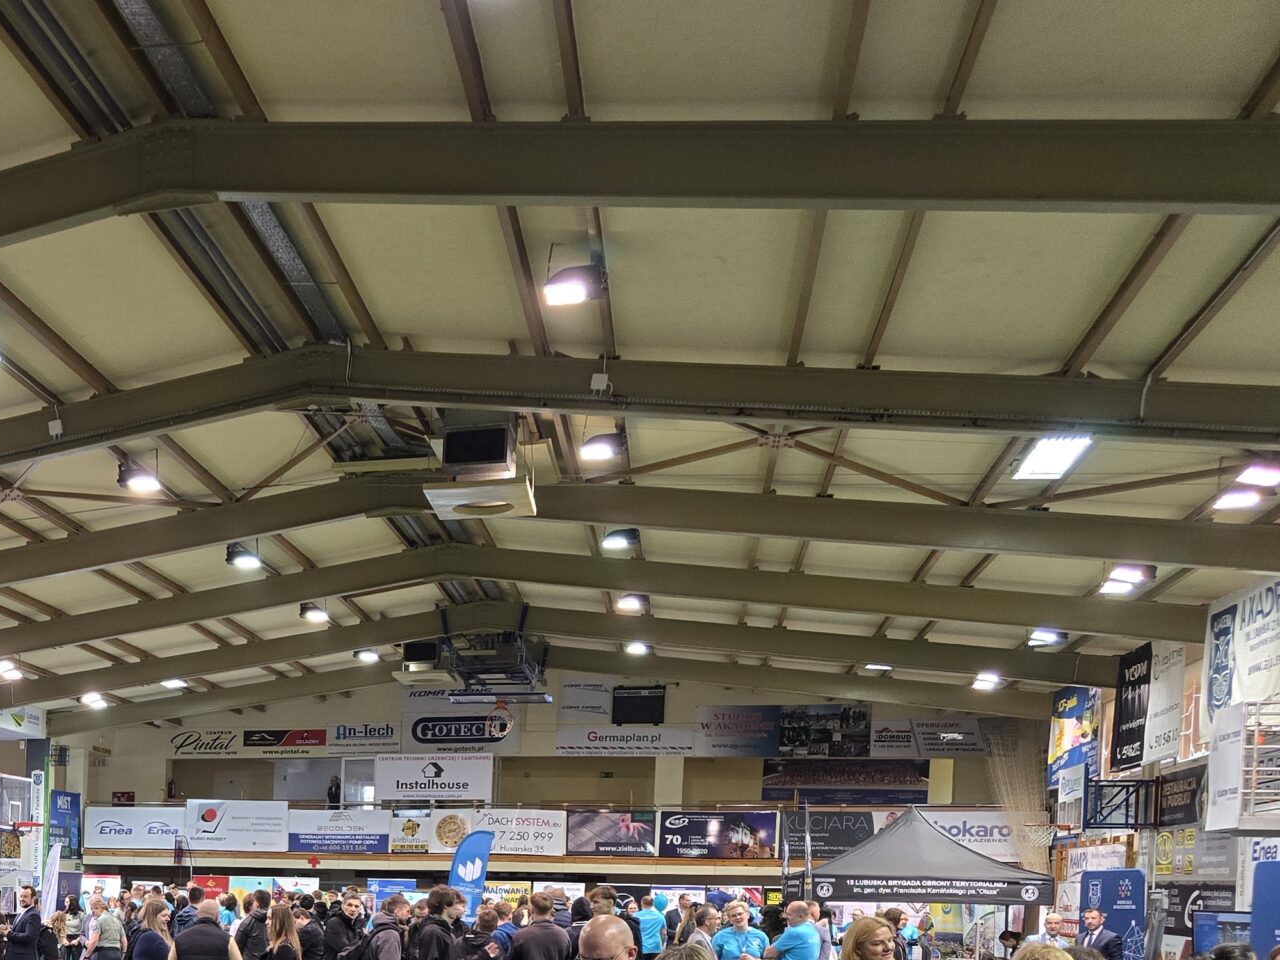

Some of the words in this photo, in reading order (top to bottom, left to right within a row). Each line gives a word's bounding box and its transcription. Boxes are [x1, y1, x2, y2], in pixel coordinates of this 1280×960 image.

[409, 690, 445, 698] KOMA
[336, 724, 394, 740] An-Tech
[587, 731, 661, 744] Germaplan.pl
[170, 730, 238, 756] Pintal
[396, 779, 469, 790] Instalhouse
[487, 816, 513, 825] DACH
[99, 826, 132, 835] Enea
[148, 826, 178, 835] Enea
[509, 831, 529, 841] 250
[533, 832, 554, 841] 999
[664, 834, 682, 845] 70
[499, 844, 532, 852] Husarska
[534, 845, 545, 853] 35
[1252, 840, 1278, 861] Enea
[952, 880, 1008, 888] TERYTORIALNEJ
